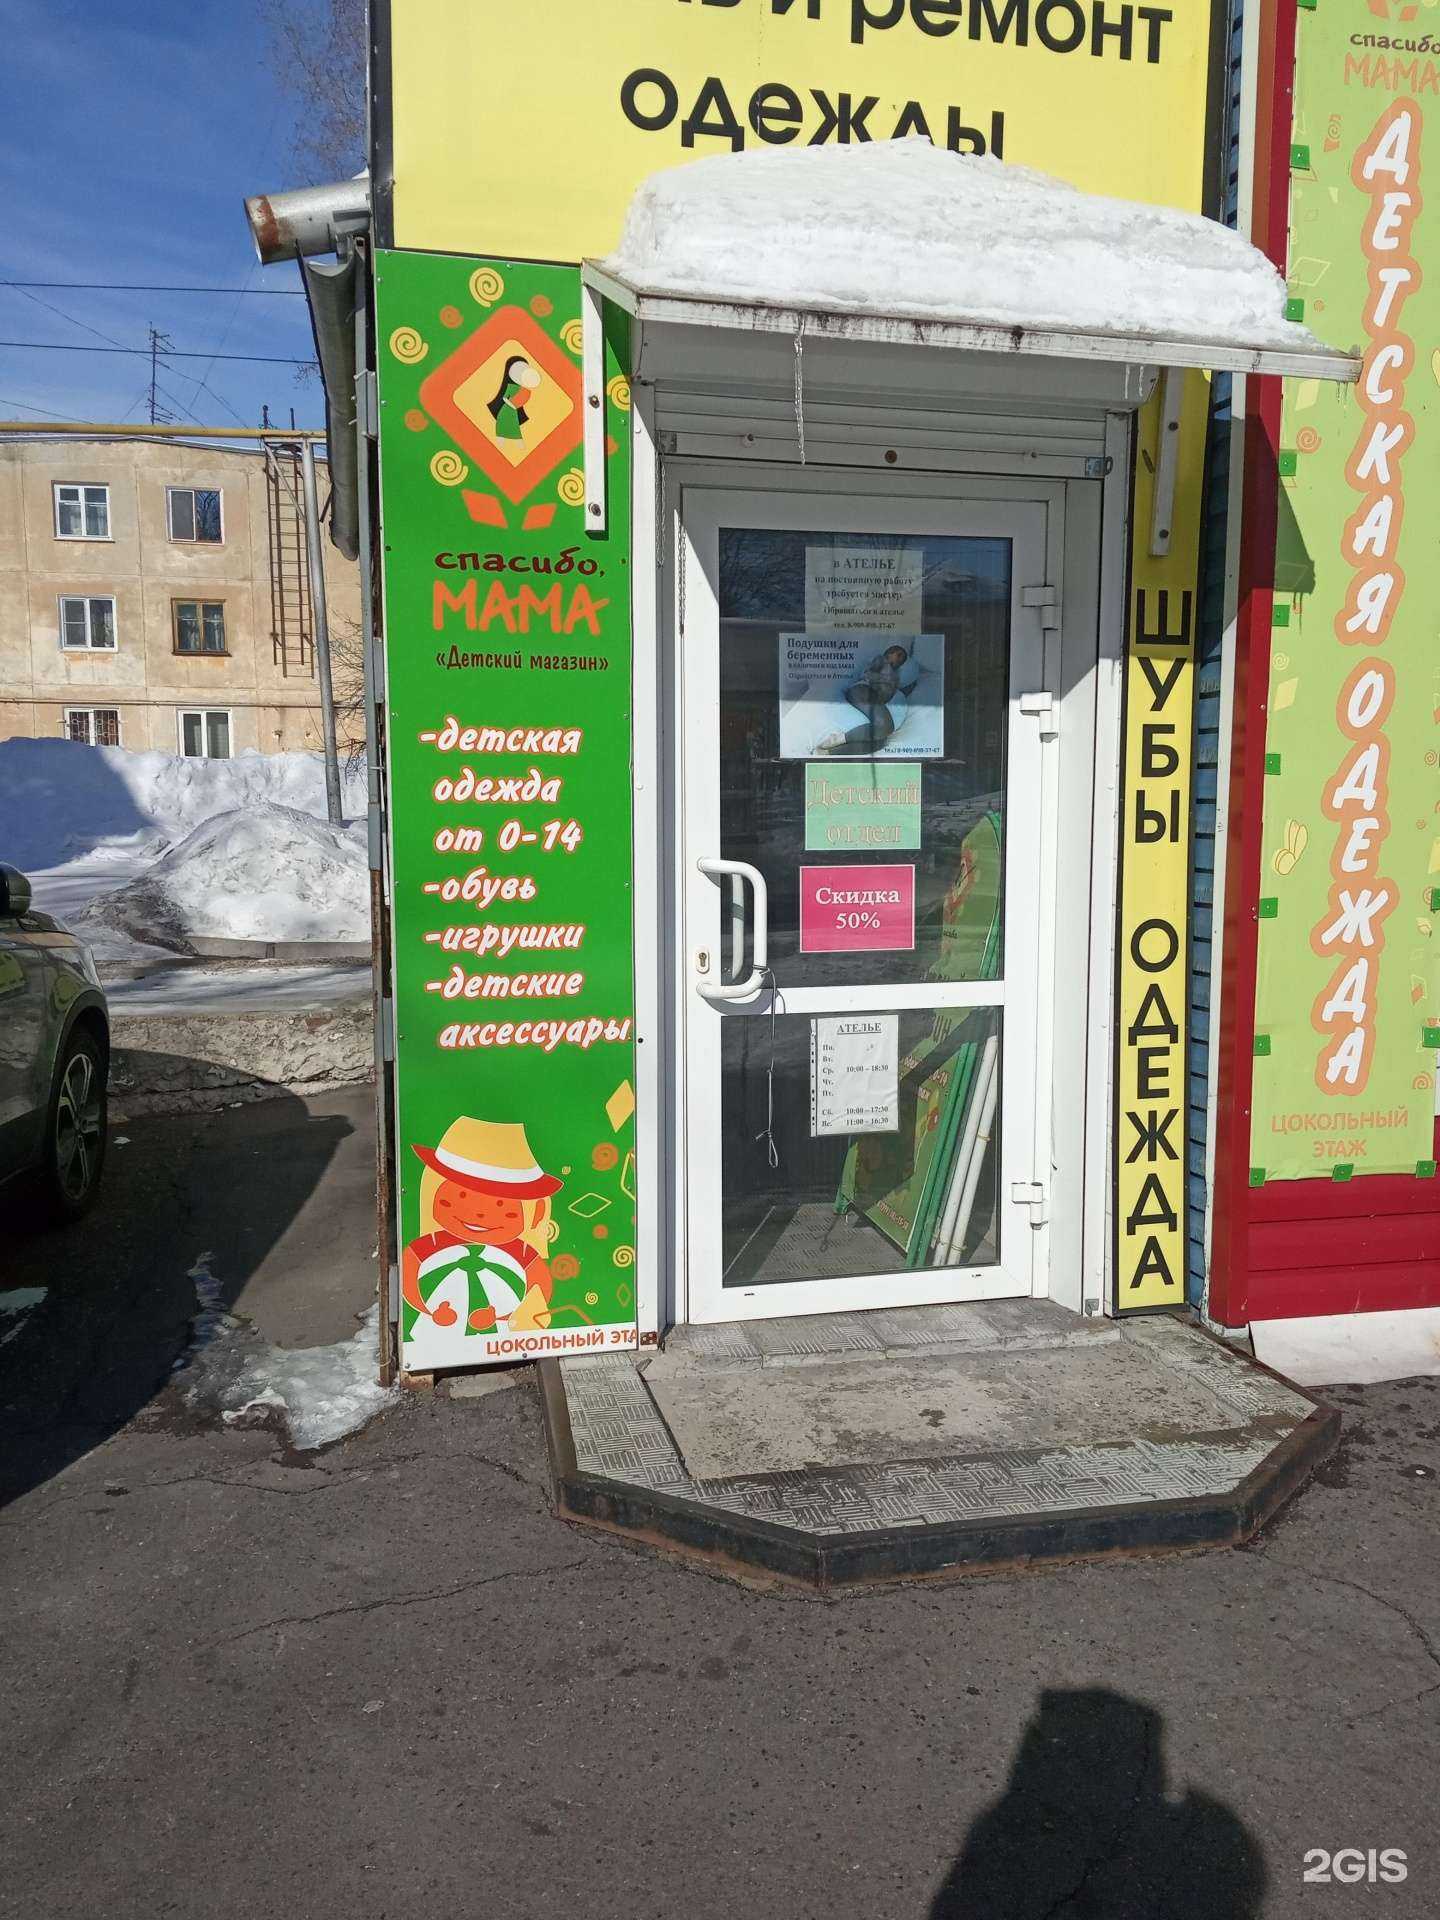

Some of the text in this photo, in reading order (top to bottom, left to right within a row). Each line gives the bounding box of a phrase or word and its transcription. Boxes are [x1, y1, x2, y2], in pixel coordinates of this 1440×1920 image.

[1343, 51, 1440, 96] МАМА
[434, 546, 605, 577] спасибо,
[843, 558, 896, 570] АТЕЛЬЕ
[432, 578, 610, 635] МАМА
[1321, 109, 1412, 1085] ДЕТСКАЯ ОДЕЖДА
[436, 645, 609, 671] «Детский магазин»
[787, 638, 858, 650] Подушки для
[787, 650, 855, 661] беременных
[419, 715, 582, 753] -детская
[434, 767, 562, 801] одежда
[808, 778, 920, 812] Детский
[435, 820, 582, 851] от 0-14
[827, 824, 901, 845] отдел
[423, 868, 536, 909] -обувь
[815, 887, 901, 906] Скидка
[835, 911, 881, 929] 50%
[425, 924, 584, 957] -игрушки
[1126, 588, 1192, 1288] ШУБЫ ОДЕЖДА
[426, 966, 583, 999] -детские
[439, 1017, 631, 1052] аксессуары
[837, 1022, 882, 1034] АТЕЛЬЕ
[846, 1107, 864, 1115] 10:00
[846, 1118, 864, 1126] 11:00
[1271, 1105, 1409, 1135] ЦОКОЛЬНЫЙ
[1313, 1139, 1367, 1158] ЭТАЖ
[487, 1328, 637, 1355] ЦОКОЛЬНЫЙ ЭТА
